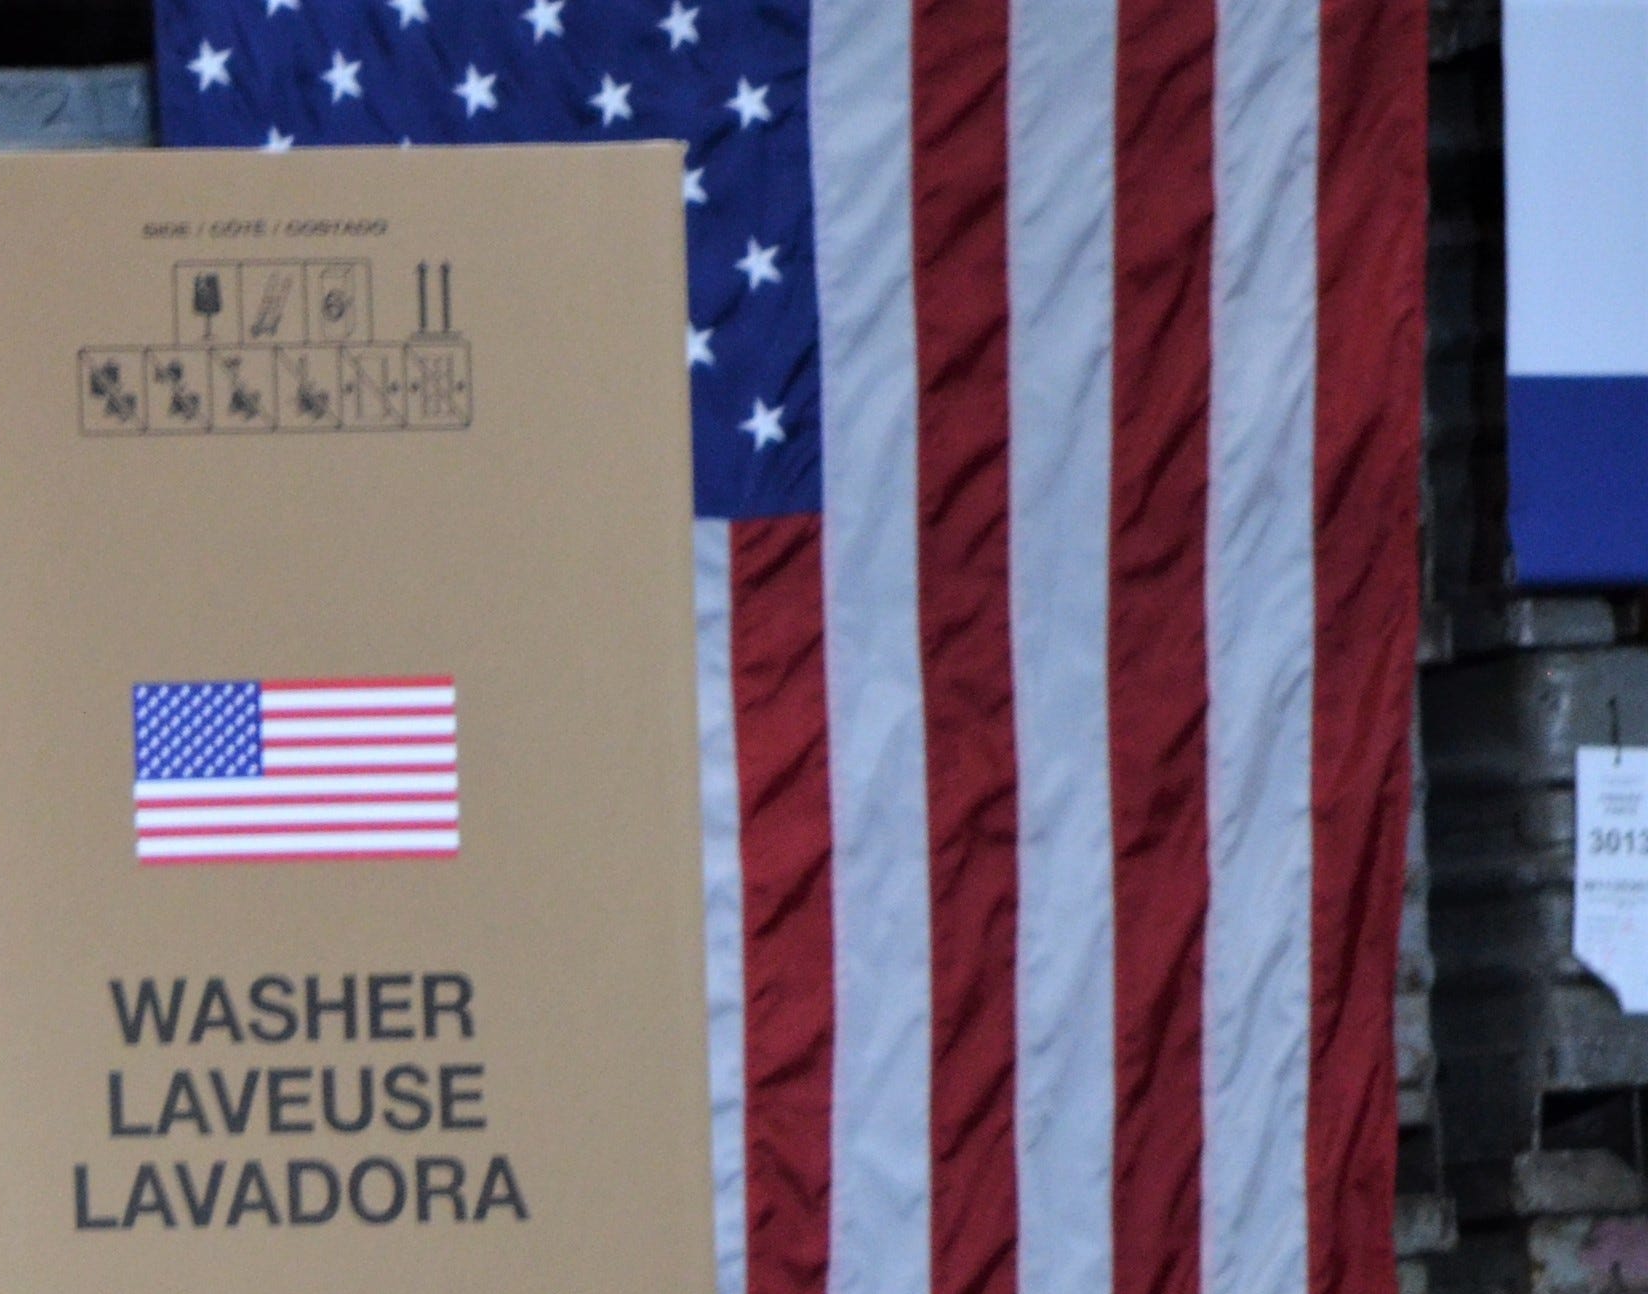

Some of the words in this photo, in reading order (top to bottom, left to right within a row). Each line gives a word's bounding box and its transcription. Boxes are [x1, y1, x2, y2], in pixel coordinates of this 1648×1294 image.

[109, 974, 475, 1045] WASHER
[109, 1064, 487, 1137] LAVEUSE
[73, 1154, 530, 1230] LAVADORA
